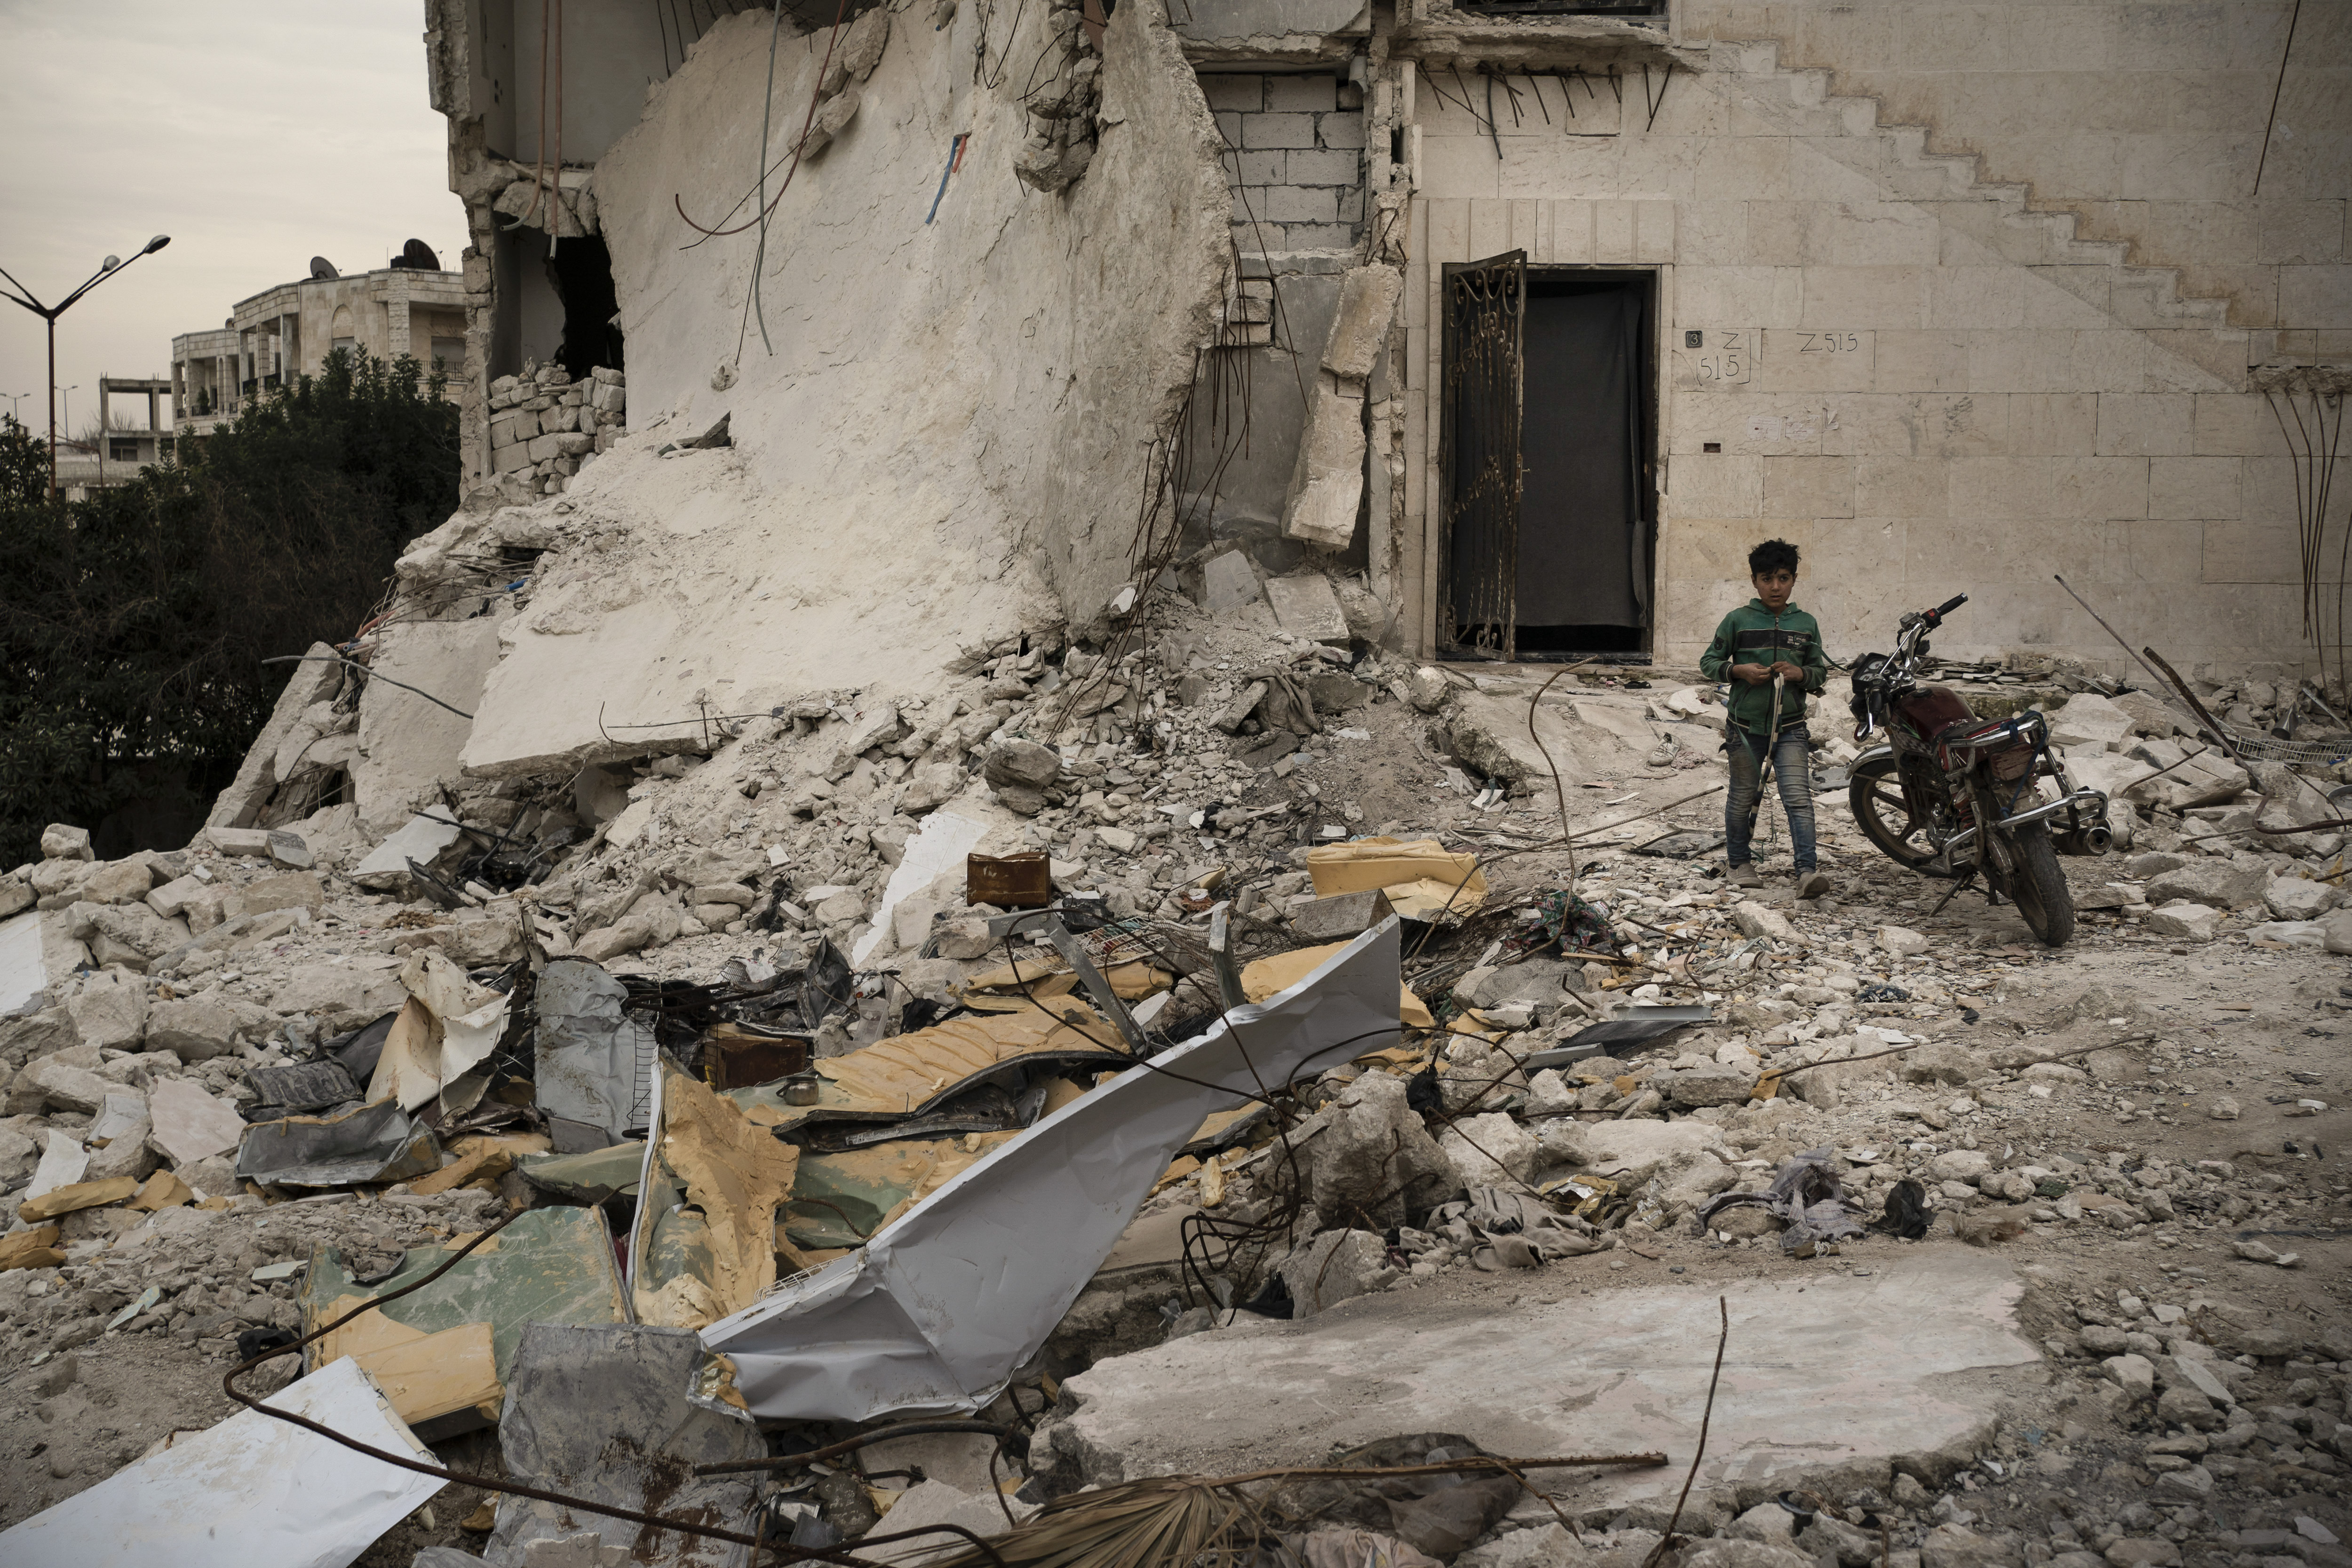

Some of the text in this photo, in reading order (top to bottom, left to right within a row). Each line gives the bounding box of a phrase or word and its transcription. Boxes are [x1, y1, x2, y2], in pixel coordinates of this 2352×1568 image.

[1691, 334, 1698, 345] 3
[1721, 332, 1742, 349] Z
[1701, 355, 1740, 380] 515
